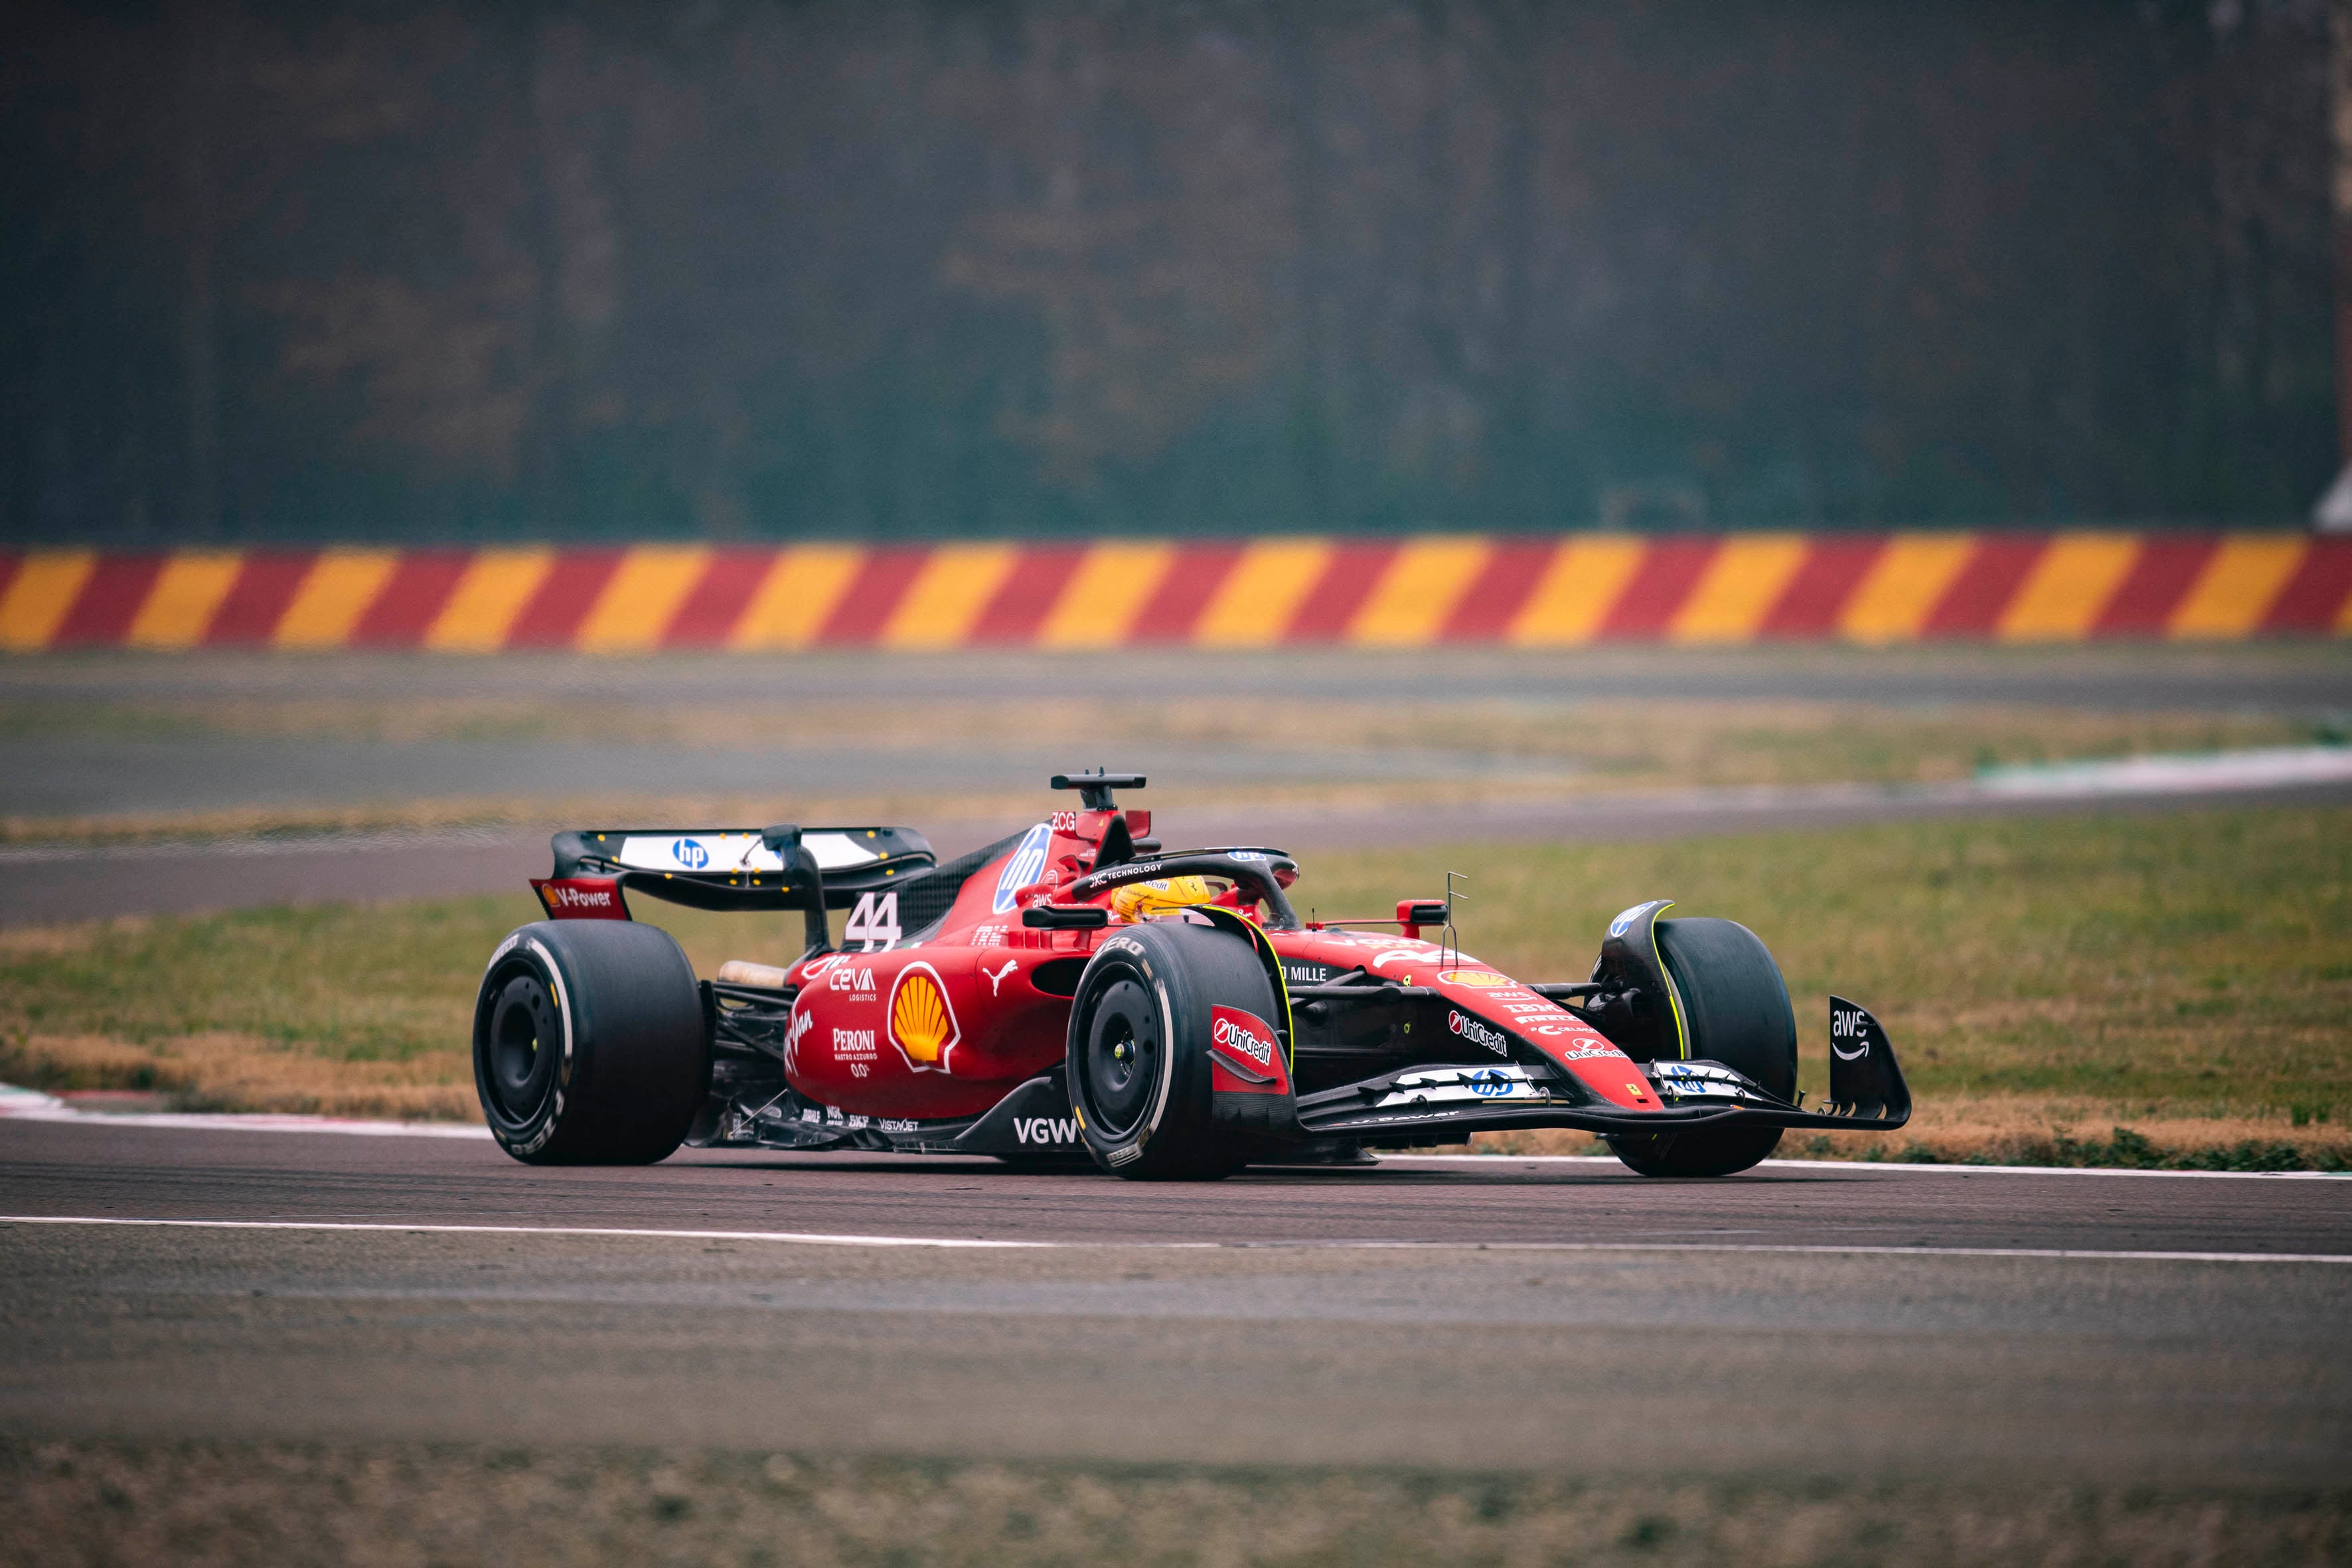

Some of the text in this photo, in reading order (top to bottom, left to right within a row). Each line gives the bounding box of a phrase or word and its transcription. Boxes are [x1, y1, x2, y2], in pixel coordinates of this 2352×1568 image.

[1052, 812, 1075, 830] ZCG
[678, 838, 704, 869] hp
[1107, 864, 1162, 880] TECHNOLOGY
[557, 889, 610, 907] V-Power
[1032, 894, 1052, 908] aws
[845, 892, 902, 953] 44
[1291, 967, 1326, 982] MILLE
[1502, 1004, 1563, 1013] IBM
[1833, 1010, 1867, 1037] aws
[832, 1028, 875, 1051] PERONI
[1229, 1023, 1272, 1066] UniCredit
[1461, 1016, 1507, 1057] UniCredit
[848, 1115, 869, 1127] SKF
[1014, 1118, 1075, 1143] VGW
